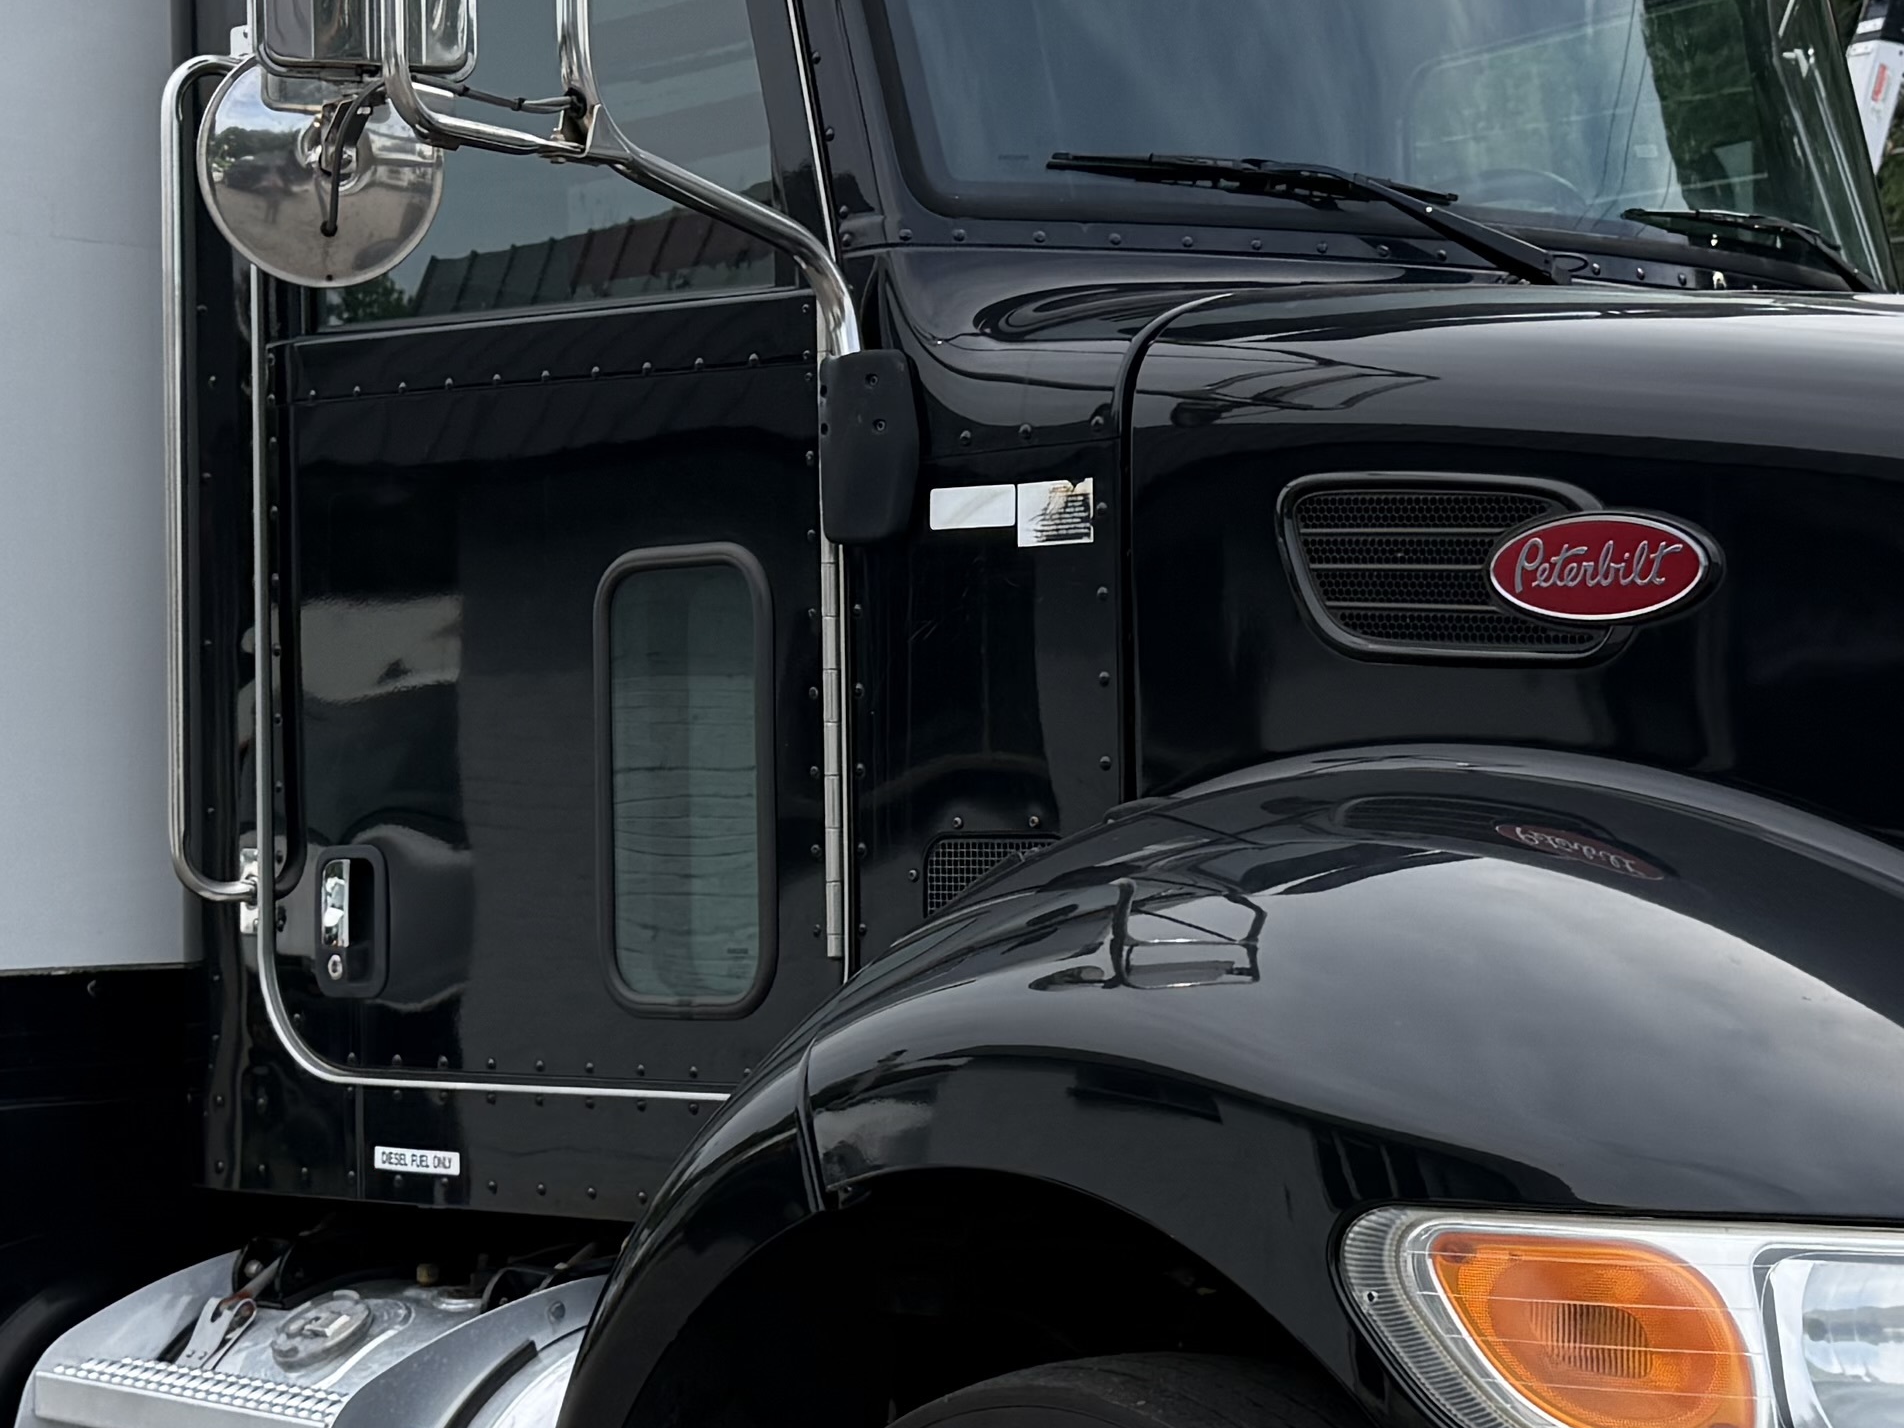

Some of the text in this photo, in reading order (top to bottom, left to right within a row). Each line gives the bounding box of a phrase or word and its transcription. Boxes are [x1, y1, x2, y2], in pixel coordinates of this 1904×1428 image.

[1513, 538, 1684, 593] Peterbilt
[381, 1150, 453, 1170] DIESEL FUEL ONLY
